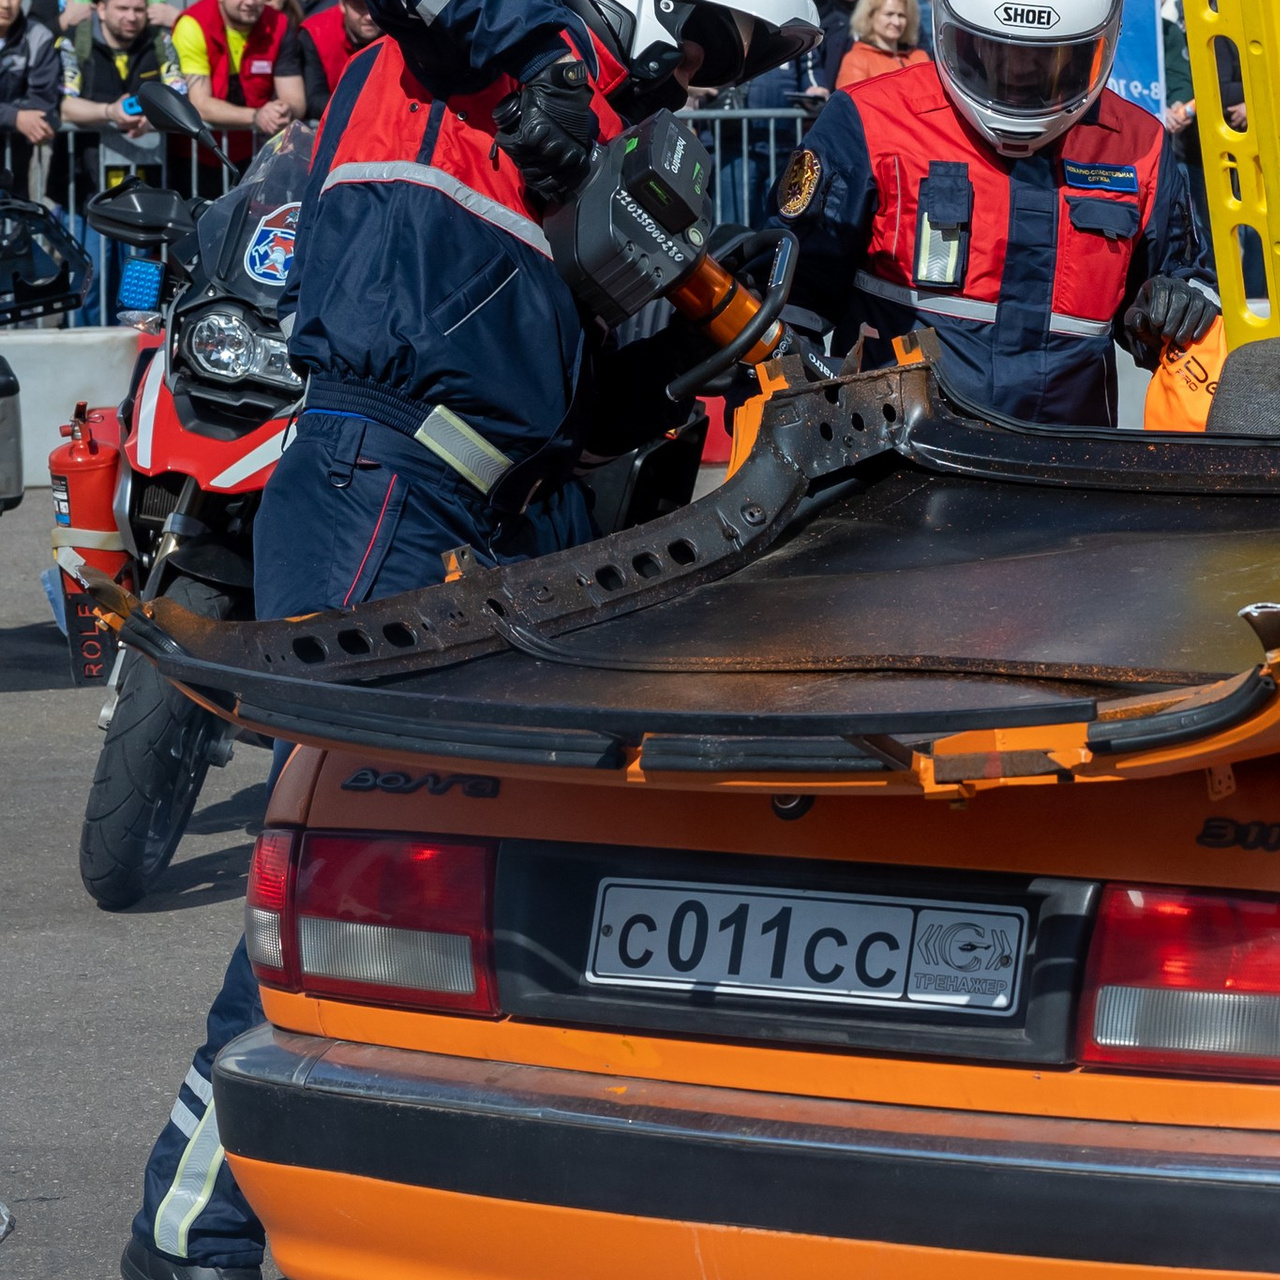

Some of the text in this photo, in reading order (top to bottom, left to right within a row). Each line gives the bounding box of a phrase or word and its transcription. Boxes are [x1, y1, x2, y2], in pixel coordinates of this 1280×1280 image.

[1003, 6, 1052, 26] SHOEI
[671, 136, 687, 174] holmatro
[914, 972, 1007, 996] ТРЕНАЖЕР
